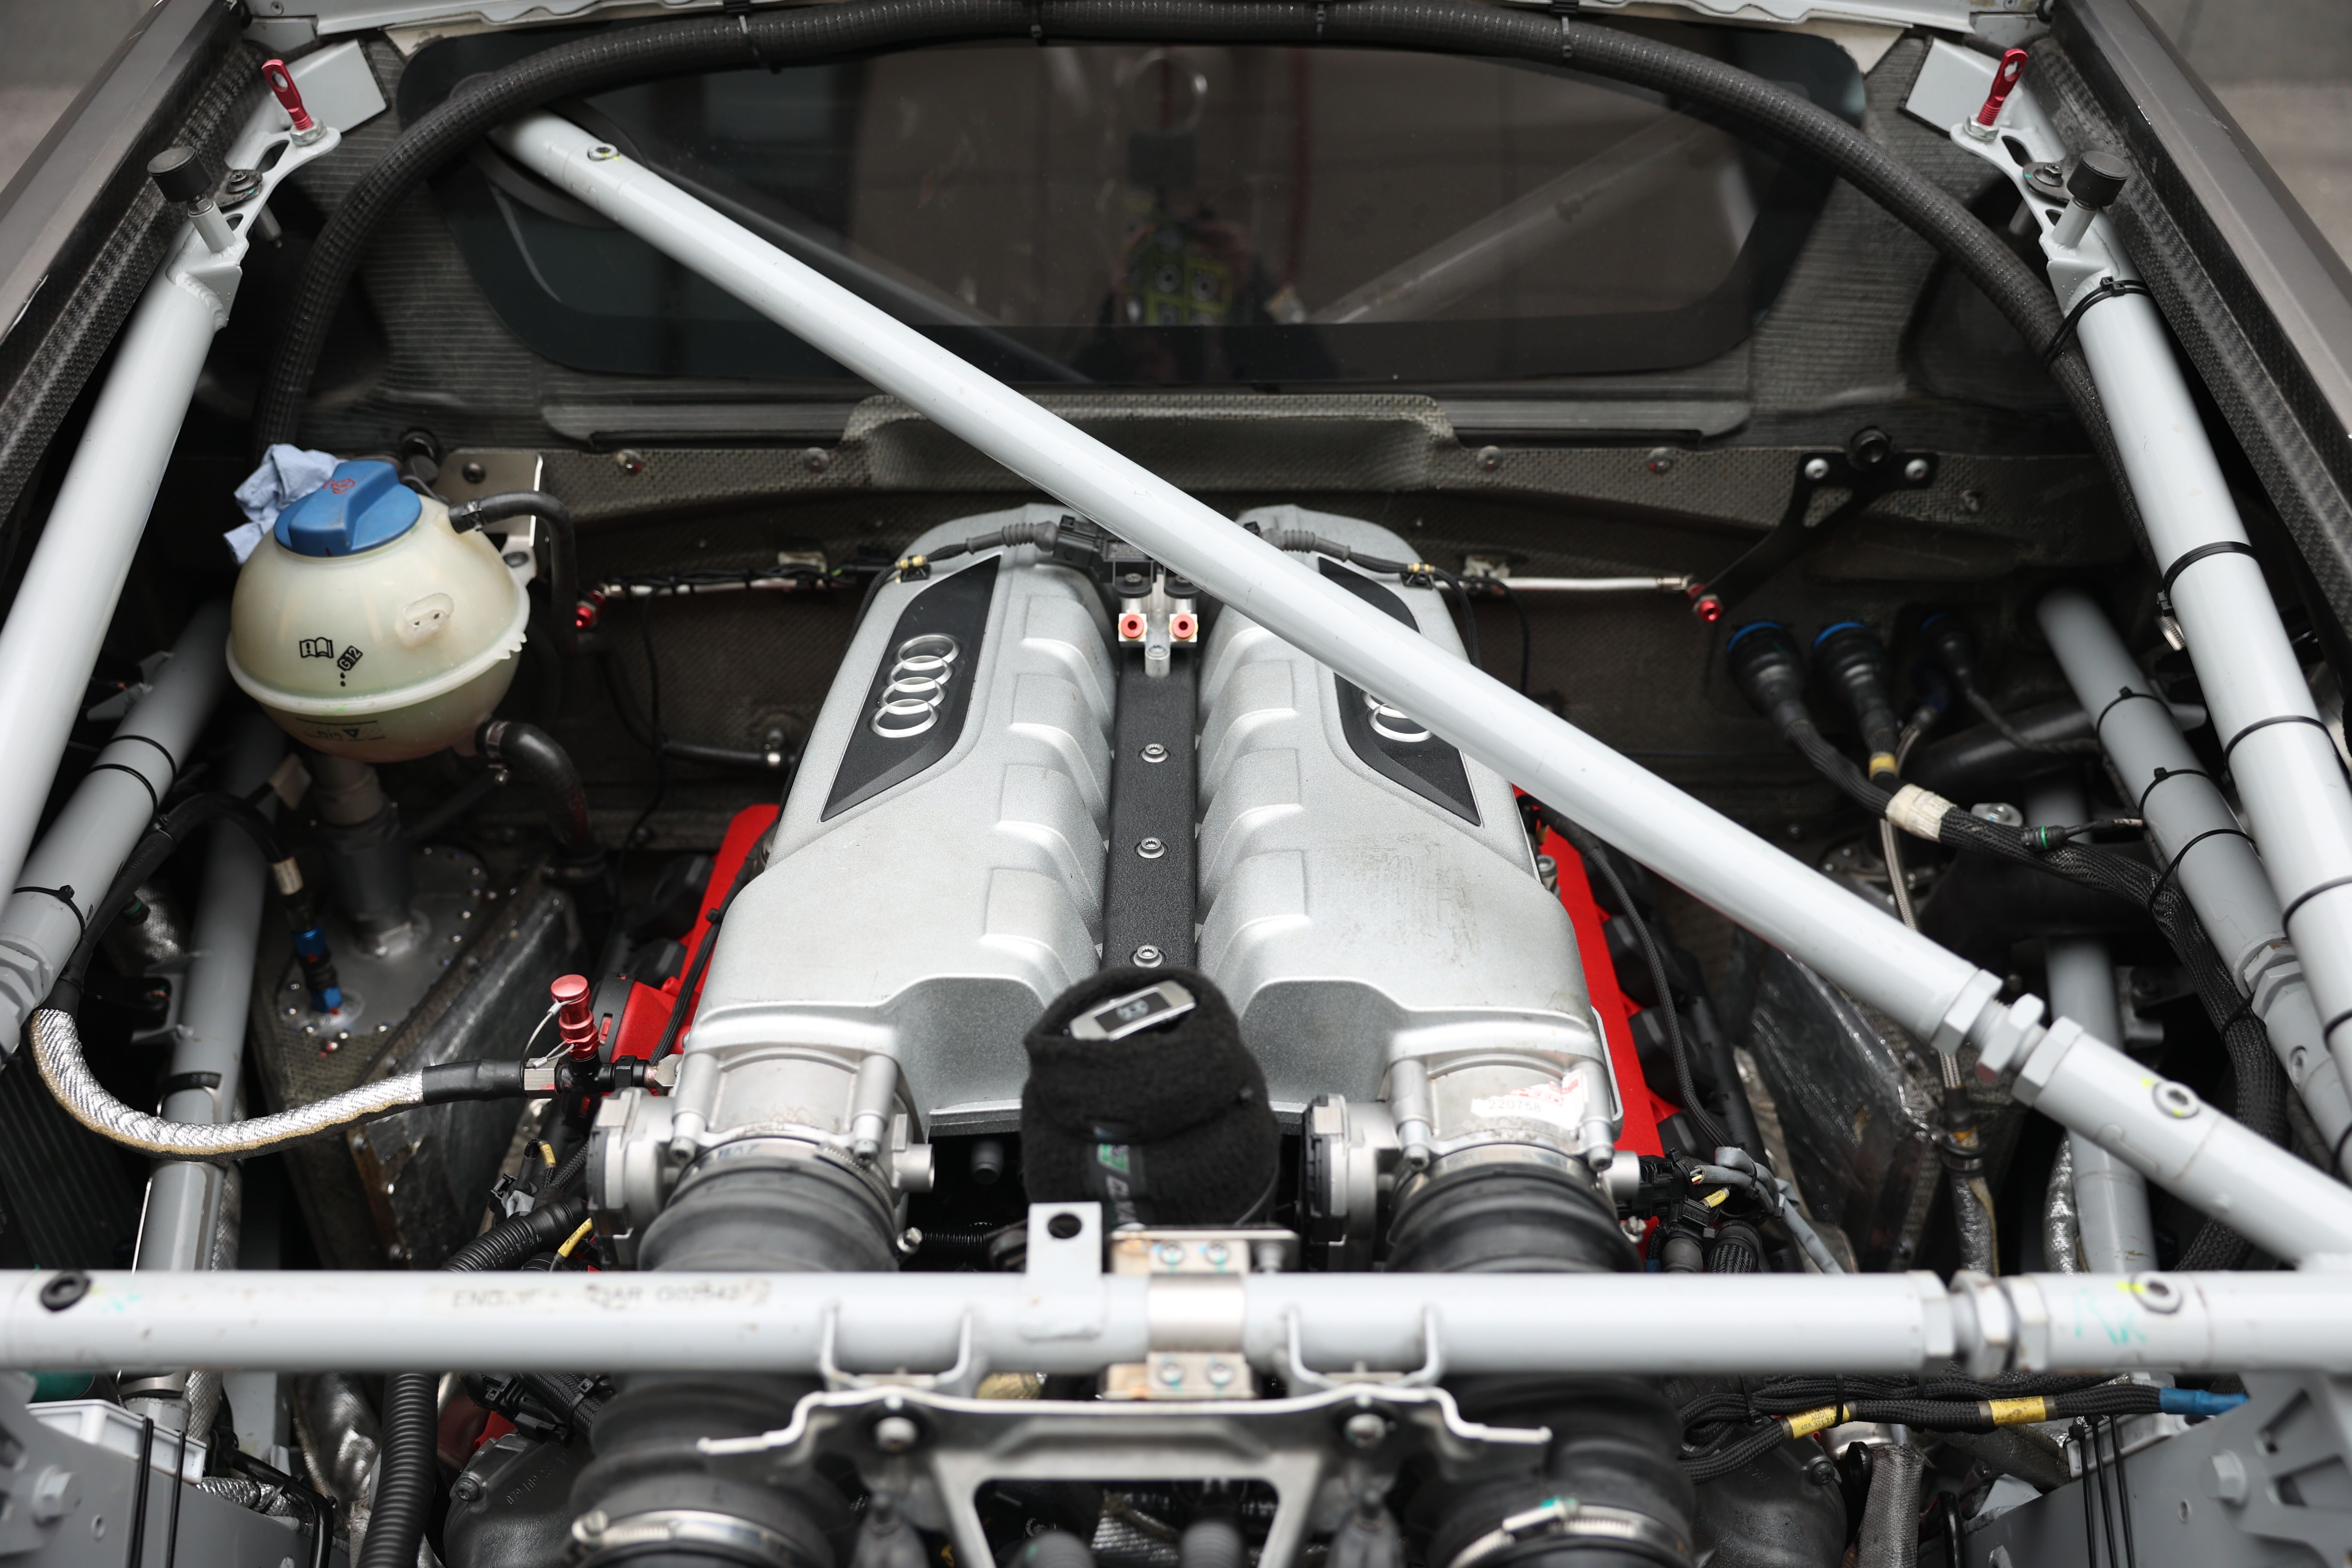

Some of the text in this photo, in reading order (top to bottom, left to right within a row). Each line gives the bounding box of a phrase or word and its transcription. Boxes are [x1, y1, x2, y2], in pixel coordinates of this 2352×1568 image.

[339, 647, 362, 669] G12
[1488, 1099, 1541, 1112] 220758
[1810, 1411, 1826, 1421] AUDI
